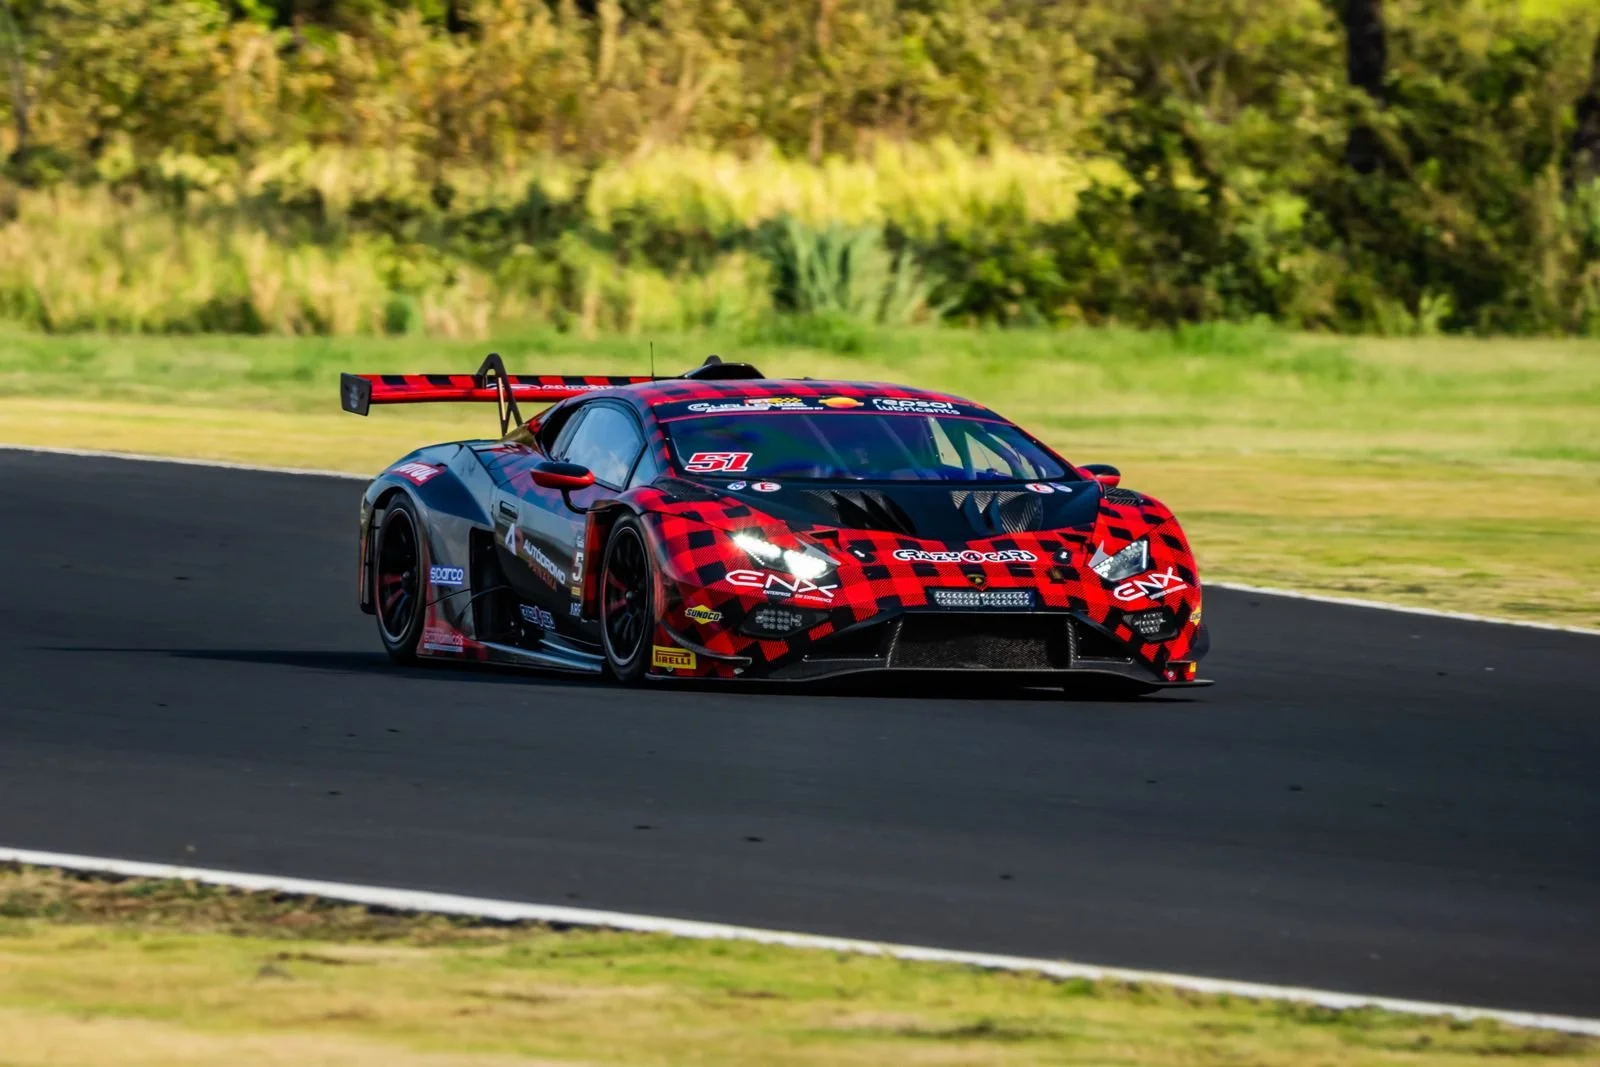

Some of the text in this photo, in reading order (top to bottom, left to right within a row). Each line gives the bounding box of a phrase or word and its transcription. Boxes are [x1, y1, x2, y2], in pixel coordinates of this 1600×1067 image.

[872, 399, 953, 409] repsol
[876, 405, 960, 415] lubricants
[684, 452, 753, 472] 51
[430, 567, 464, 583] sparco
[725, 569, 838, 598] ENX
[1113, 566, 1184, 601] ENX
[686, 608, 720, 620] SUNOCO
[656, 650, 691, 665] PIRELLI
